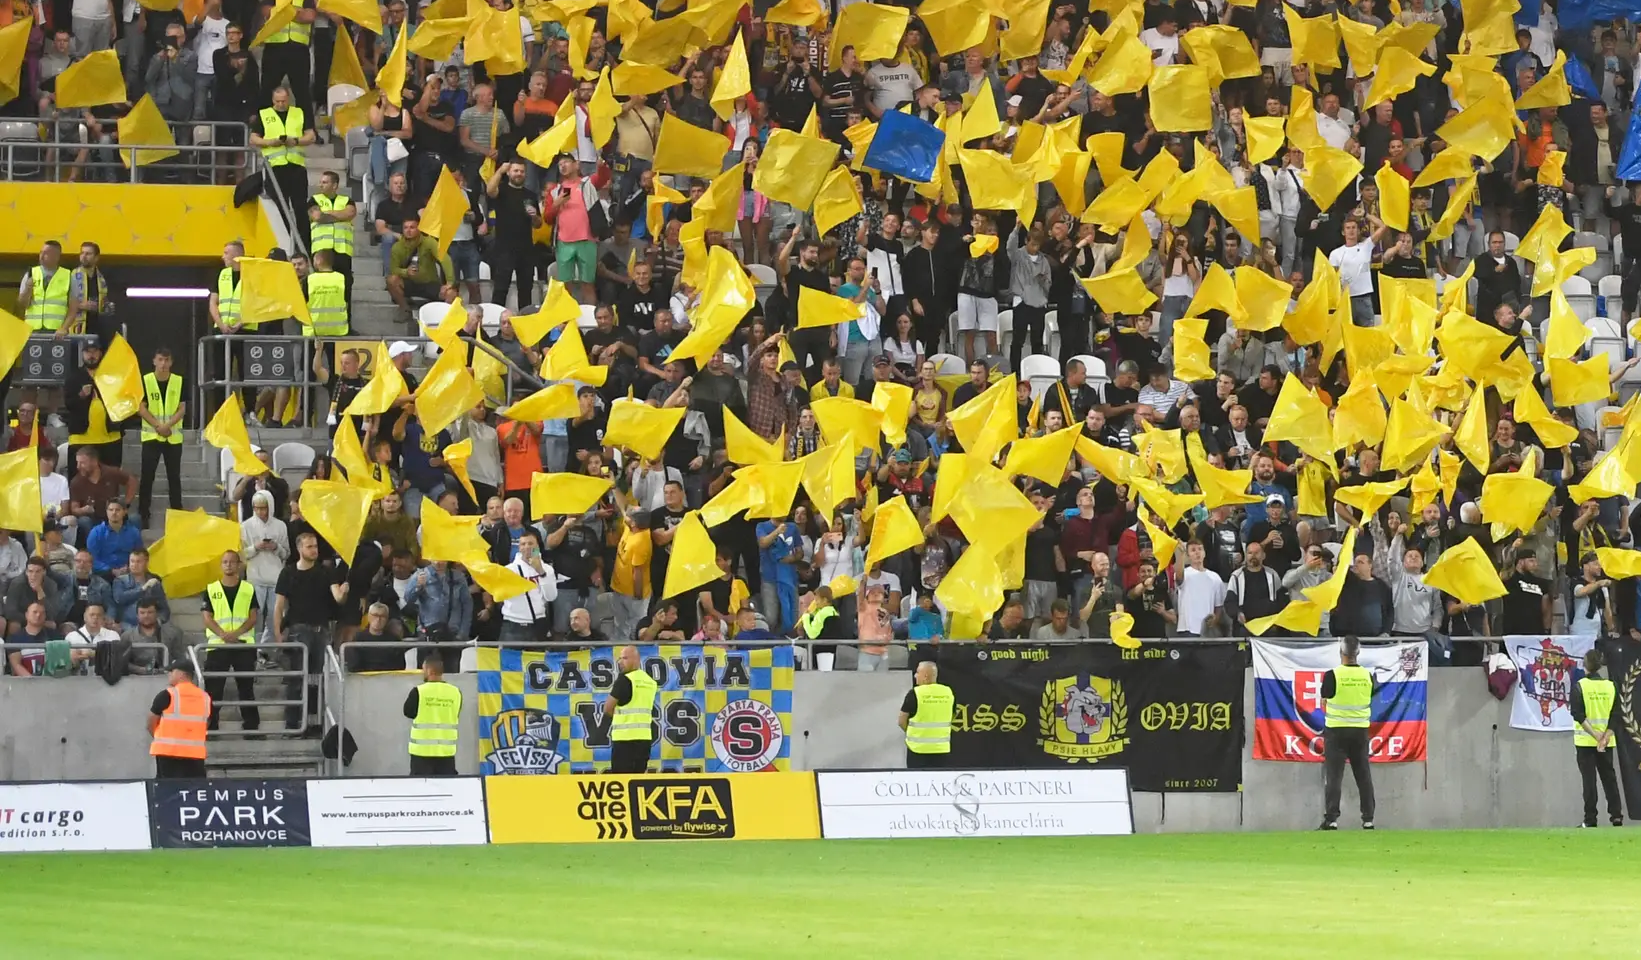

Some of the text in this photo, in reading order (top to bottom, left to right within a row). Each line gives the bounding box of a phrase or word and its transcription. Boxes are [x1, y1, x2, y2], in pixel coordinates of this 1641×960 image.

[879, 73, 910, 83] SPARTA
[265, 116, 277, 125] 58
[150, 392, 161, 401] 19
[211, 591, 223, 600] 49
[990, 648, 1167, 662] good night left side
[526, 655, 751, 690] CASOVIA
[951, 701, 1233, 733] ASS OVIA
[1052, 742, 1117, 756] PSIE HLAVY
[1284, 734, 1405, 756] KOCE
[727, 758, 766, 771] FOTBAL
[874, 778, 1073, 798] ČOLLÁK & PARTNERI
[1164, 778, 1219, 788] since 2007
[179, 789, 285, 802] TEMPUS
[578, 781, 625, 800] we
[636, 785, 728, 821] KFA
[179, 805, 286, 827] PARK
[321, 808, 475, 819] www.tempusparkrozhanovce.sk
[577, 800, 626, 821] are
[20, 809, 85, 828] cargo
[889, 811, 1065, 832] advokátska kancelária
[51, 828, 85, 838] s.r.o.
[640, 821, 717, 834] powered by flywise
[181, 829, 288, 842] ROZHANOVCE
